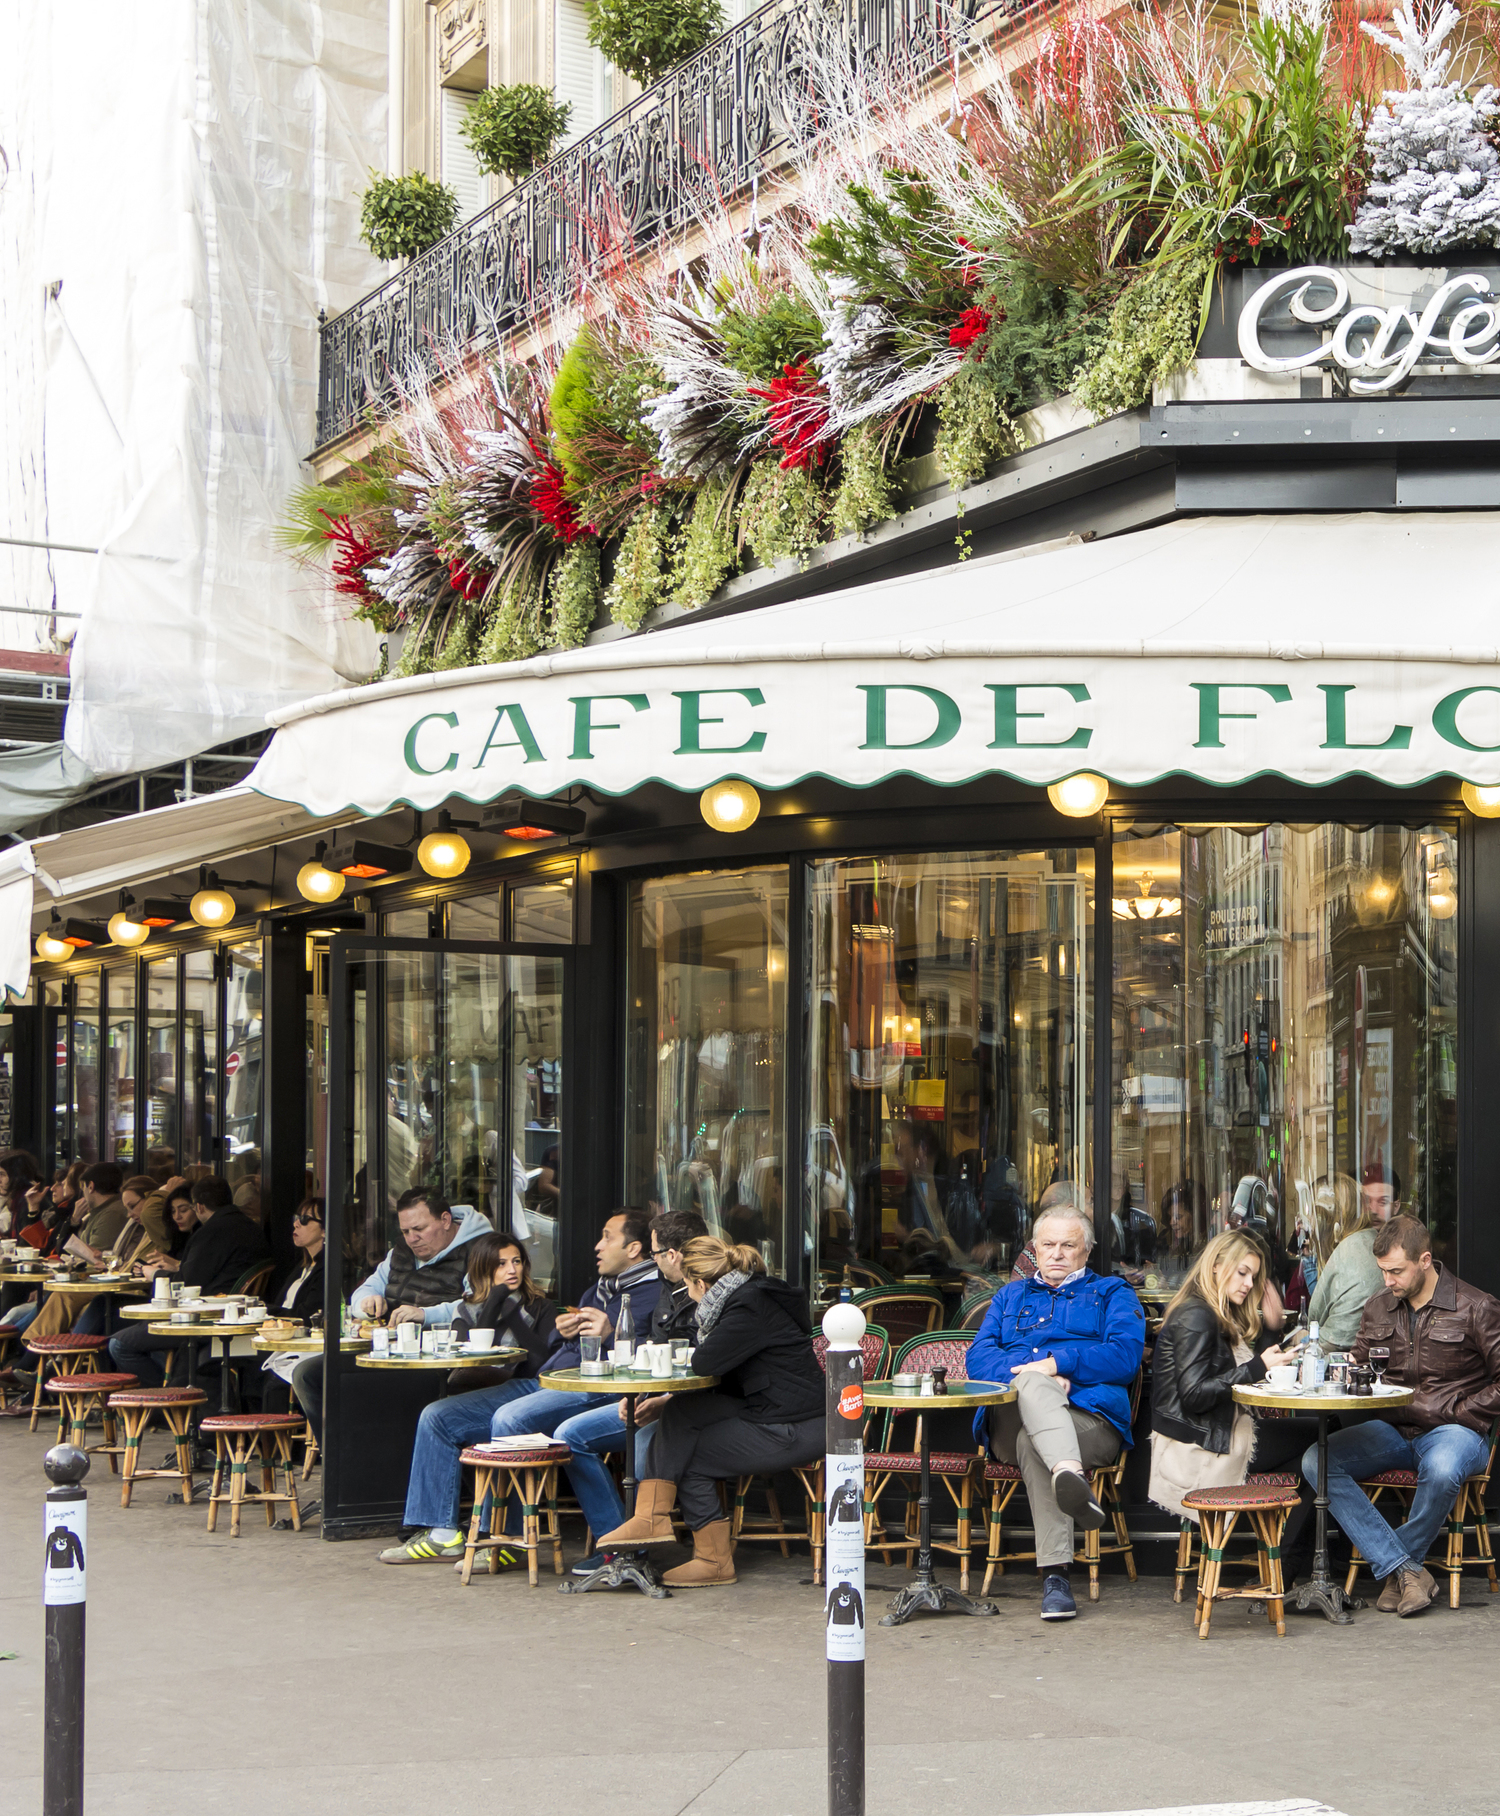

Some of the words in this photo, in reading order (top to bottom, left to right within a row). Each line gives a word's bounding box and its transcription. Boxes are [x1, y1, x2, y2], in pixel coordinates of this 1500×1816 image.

[403, 686, 768, 777] CAFE
[855, 683, 1094, 751] DE
[1210, 905, 1258, 925] BOULEVARD
[1205, 928, 1228, 943] SAINT
[1229, 924, 1265, 941] GERMAIN
[841, 1393, 862, 1405] #Avec
